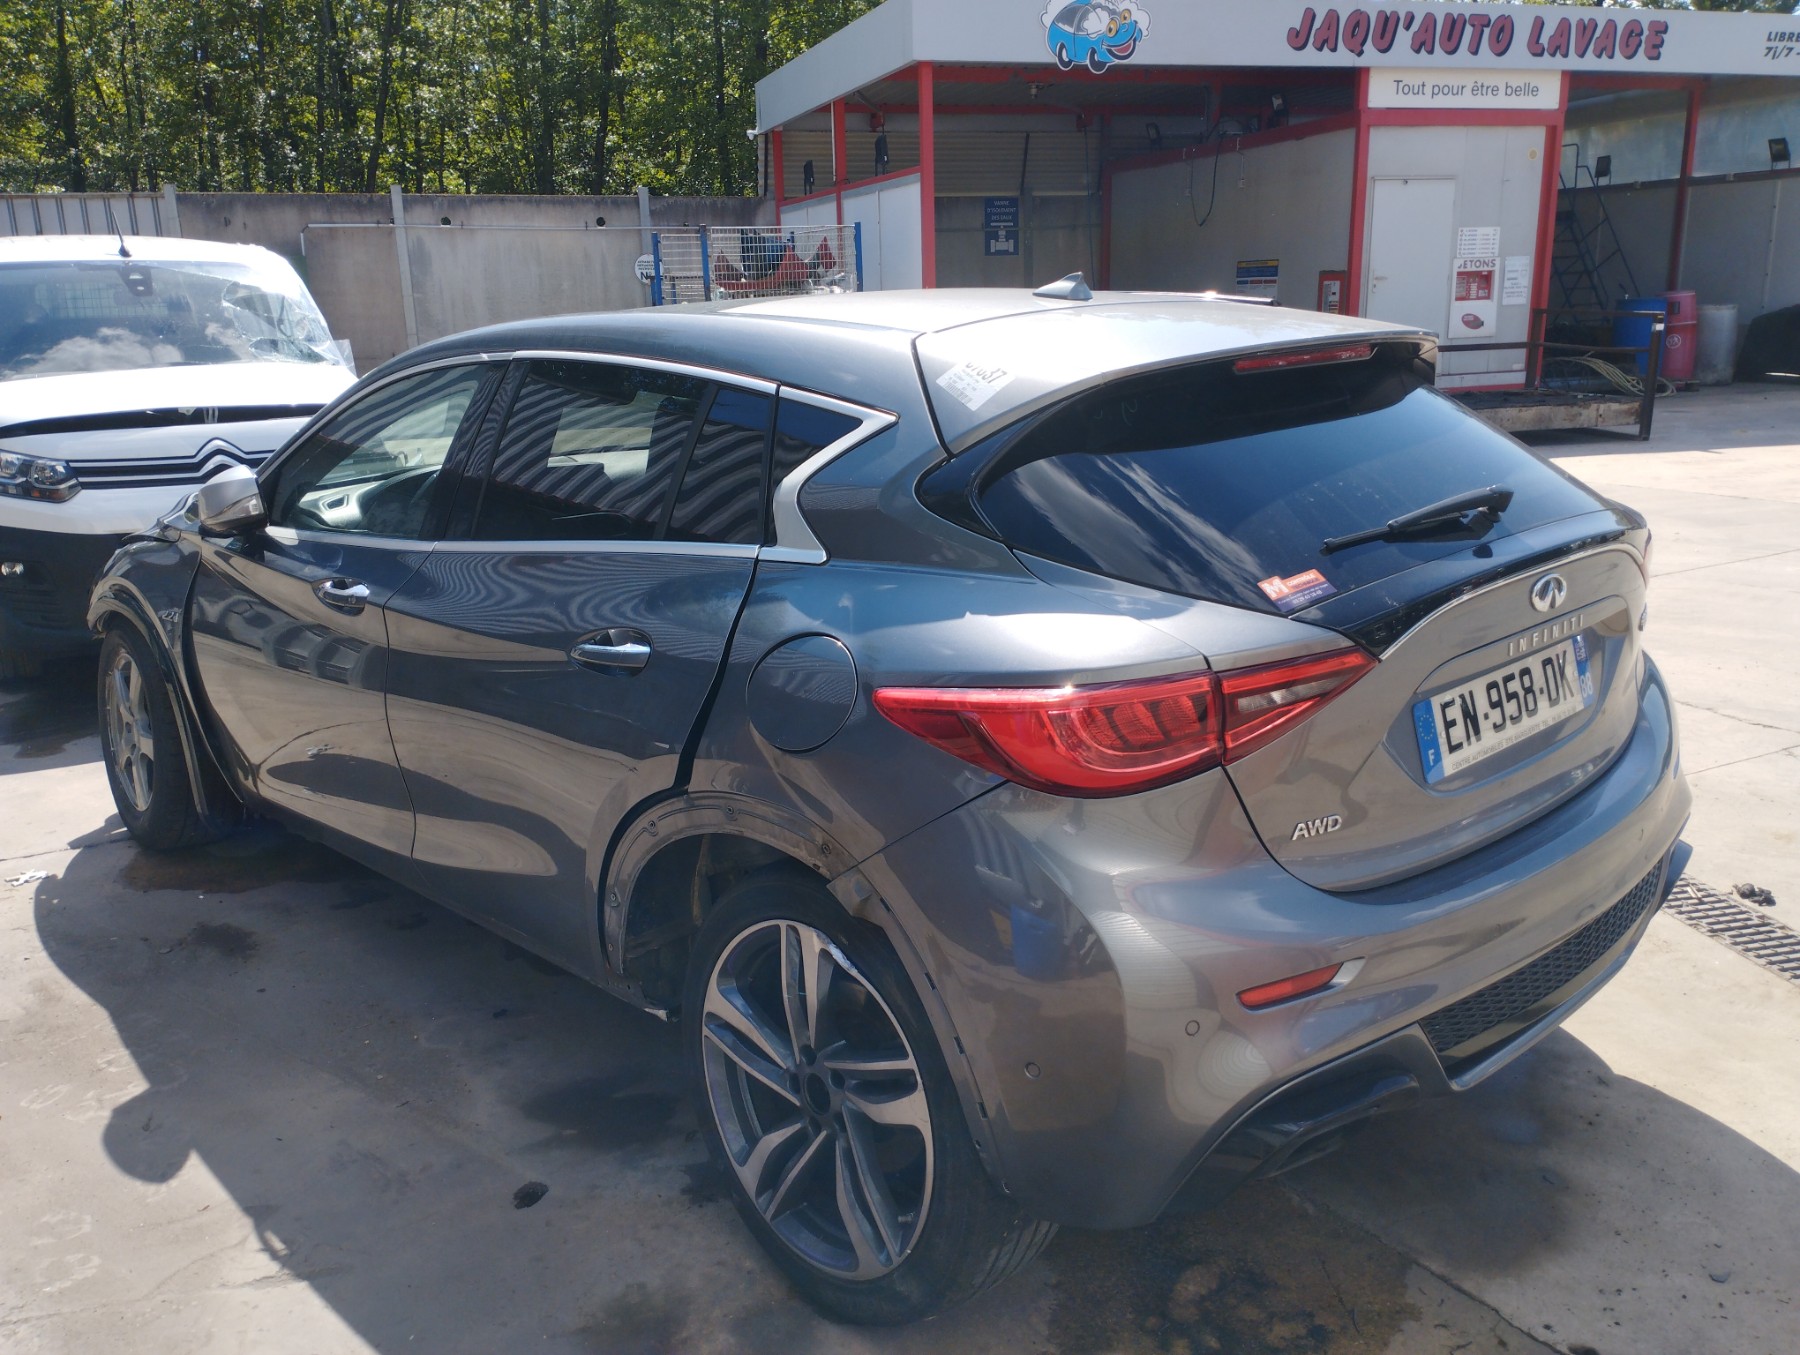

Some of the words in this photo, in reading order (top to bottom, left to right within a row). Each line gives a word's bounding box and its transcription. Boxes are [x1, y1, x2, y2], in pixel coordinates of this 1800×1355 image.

[1287, 7, 1515, 58] JAQU'AUTO
[1527, 15, 1669, 61] LAVAGE
[1393, 80, 1426, 96] Tout
[1431, 83, 1467, 99] pour
[1471, 80, 1500, 97] être
[1504, 82, 1540, 97] belle
[1508, 614, 1584, 657] INFINITI
[1428, 749, 1435, 766] F
[1440, 649, 1575, 755] EN-958-DK
[1579, 671, 1594, 699] 88
[1290, 814, 1343, 841] AWD
